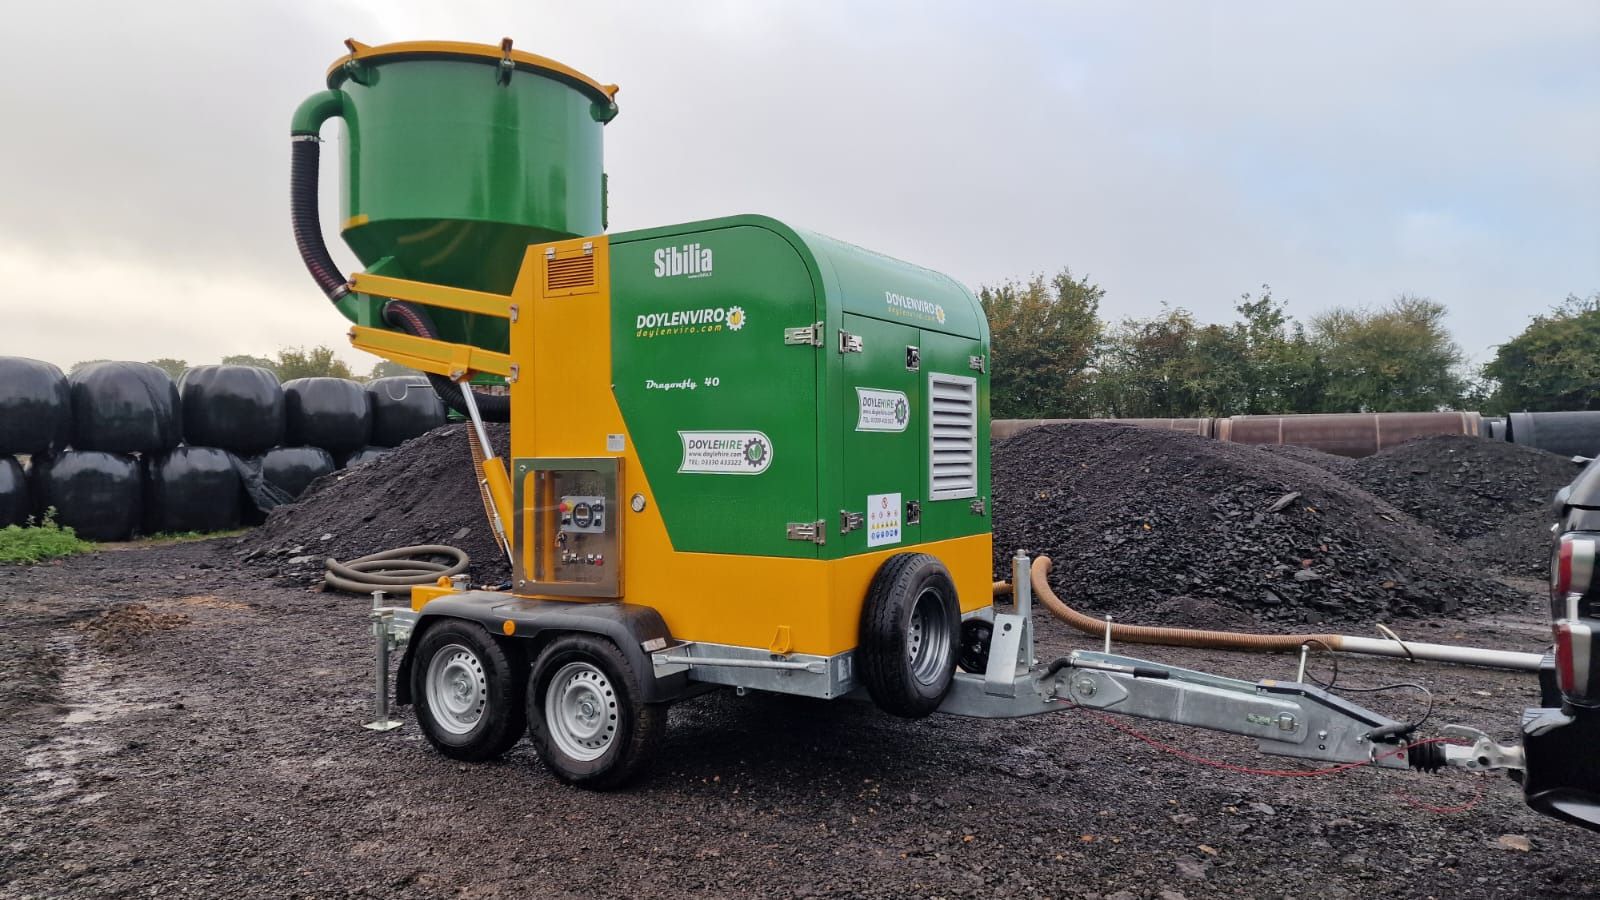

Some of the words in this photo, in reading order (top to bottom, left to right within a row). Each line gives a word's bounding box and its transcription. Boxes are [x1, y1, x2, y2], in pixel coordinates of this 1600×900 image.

[654, 243, 712, 278] Sibilia
[885, 291, 935, 314] DOYLENVIRO
[636, 307, 725, 329] DOYLENVIRO
[636, 324, 722, 338] doylenviro.com
[645, 378, 698, 391] Dragonfly
[704, 377, 720, 386] 40
[863, 396, 895, 408] DOYLEHIRE
[688, 439, 743, 450] DOYLEHIRE
